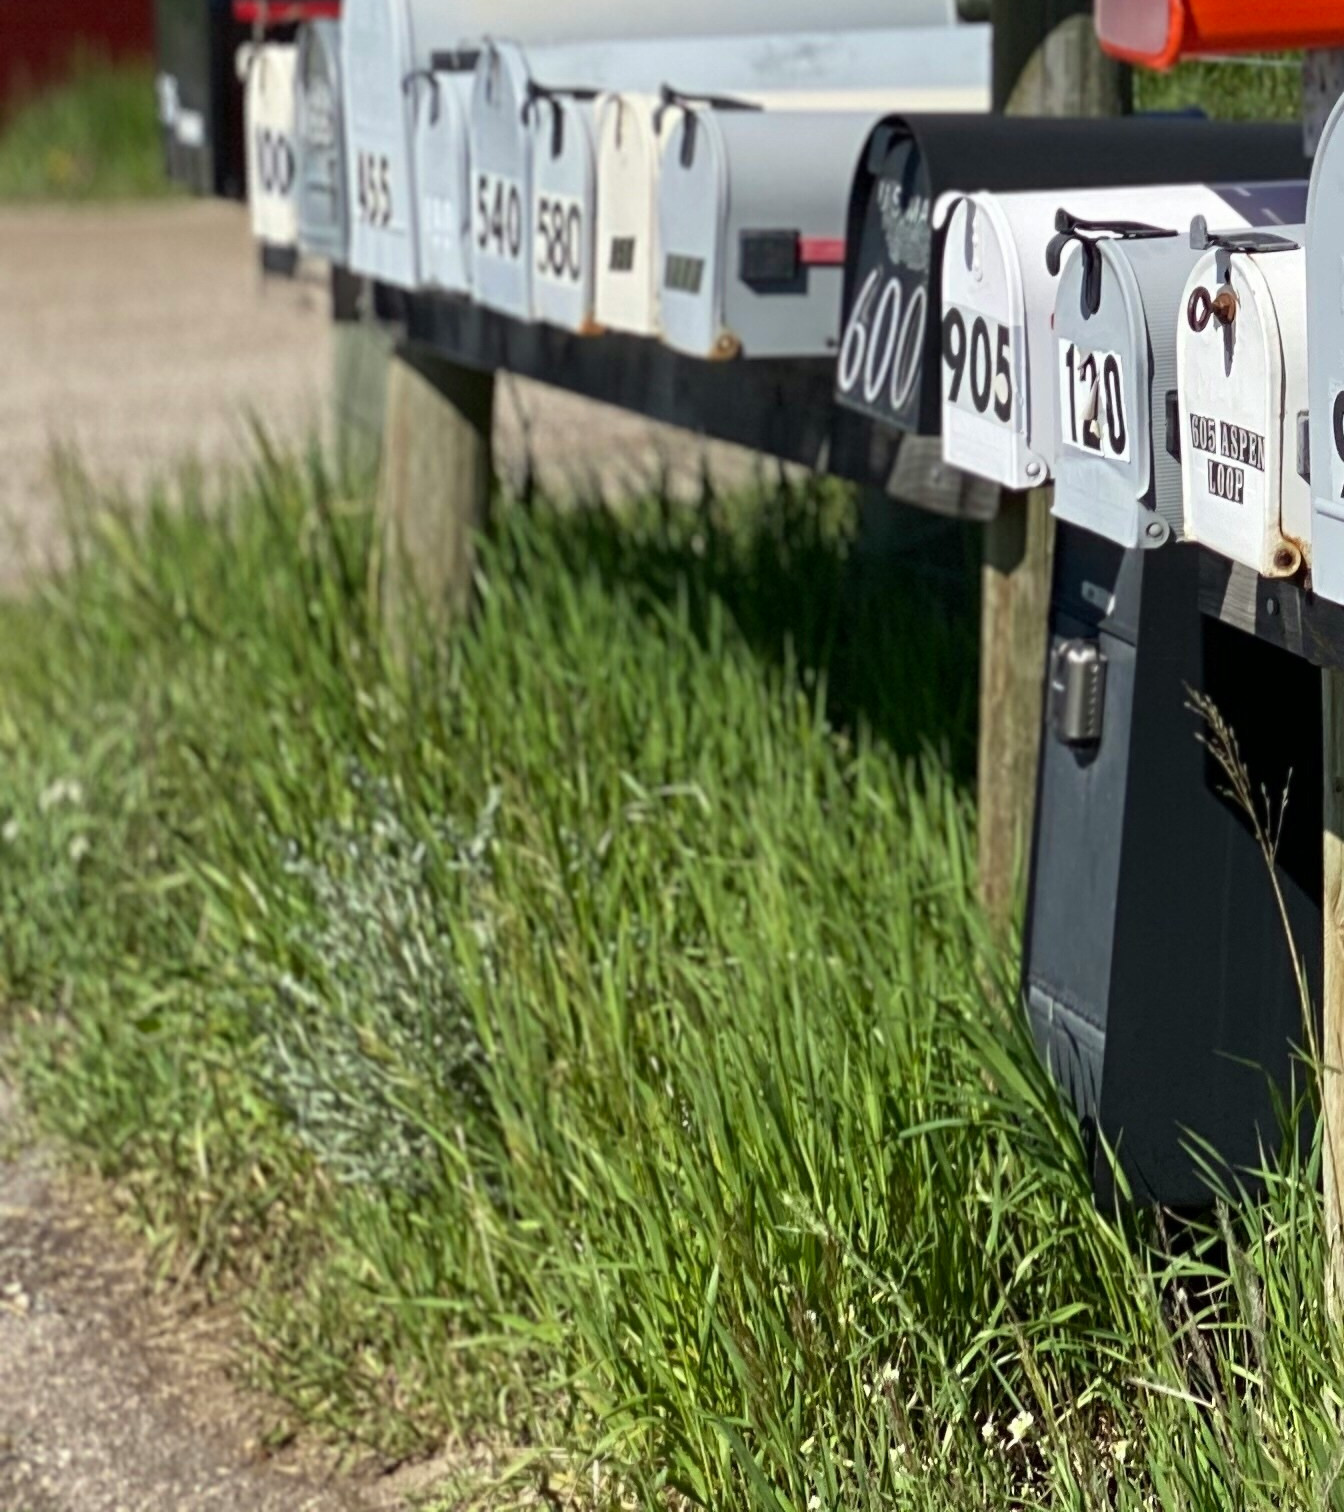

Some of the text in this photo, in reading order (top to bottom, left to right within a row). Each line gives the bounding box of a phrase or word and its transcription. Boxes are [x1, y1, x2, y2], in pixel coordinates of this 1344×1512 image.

[478, 174, 521, 258] 540
[538, 197, 581, 281] 580
[838, 269, 927, 410] 600
[942, 307, 1012, 423] 905
[1066, 344, 1126, 455] 120
[1191, 415, 1265, 471] 605 ASPEN
[1208, 461, 1244, 501] LOOP
